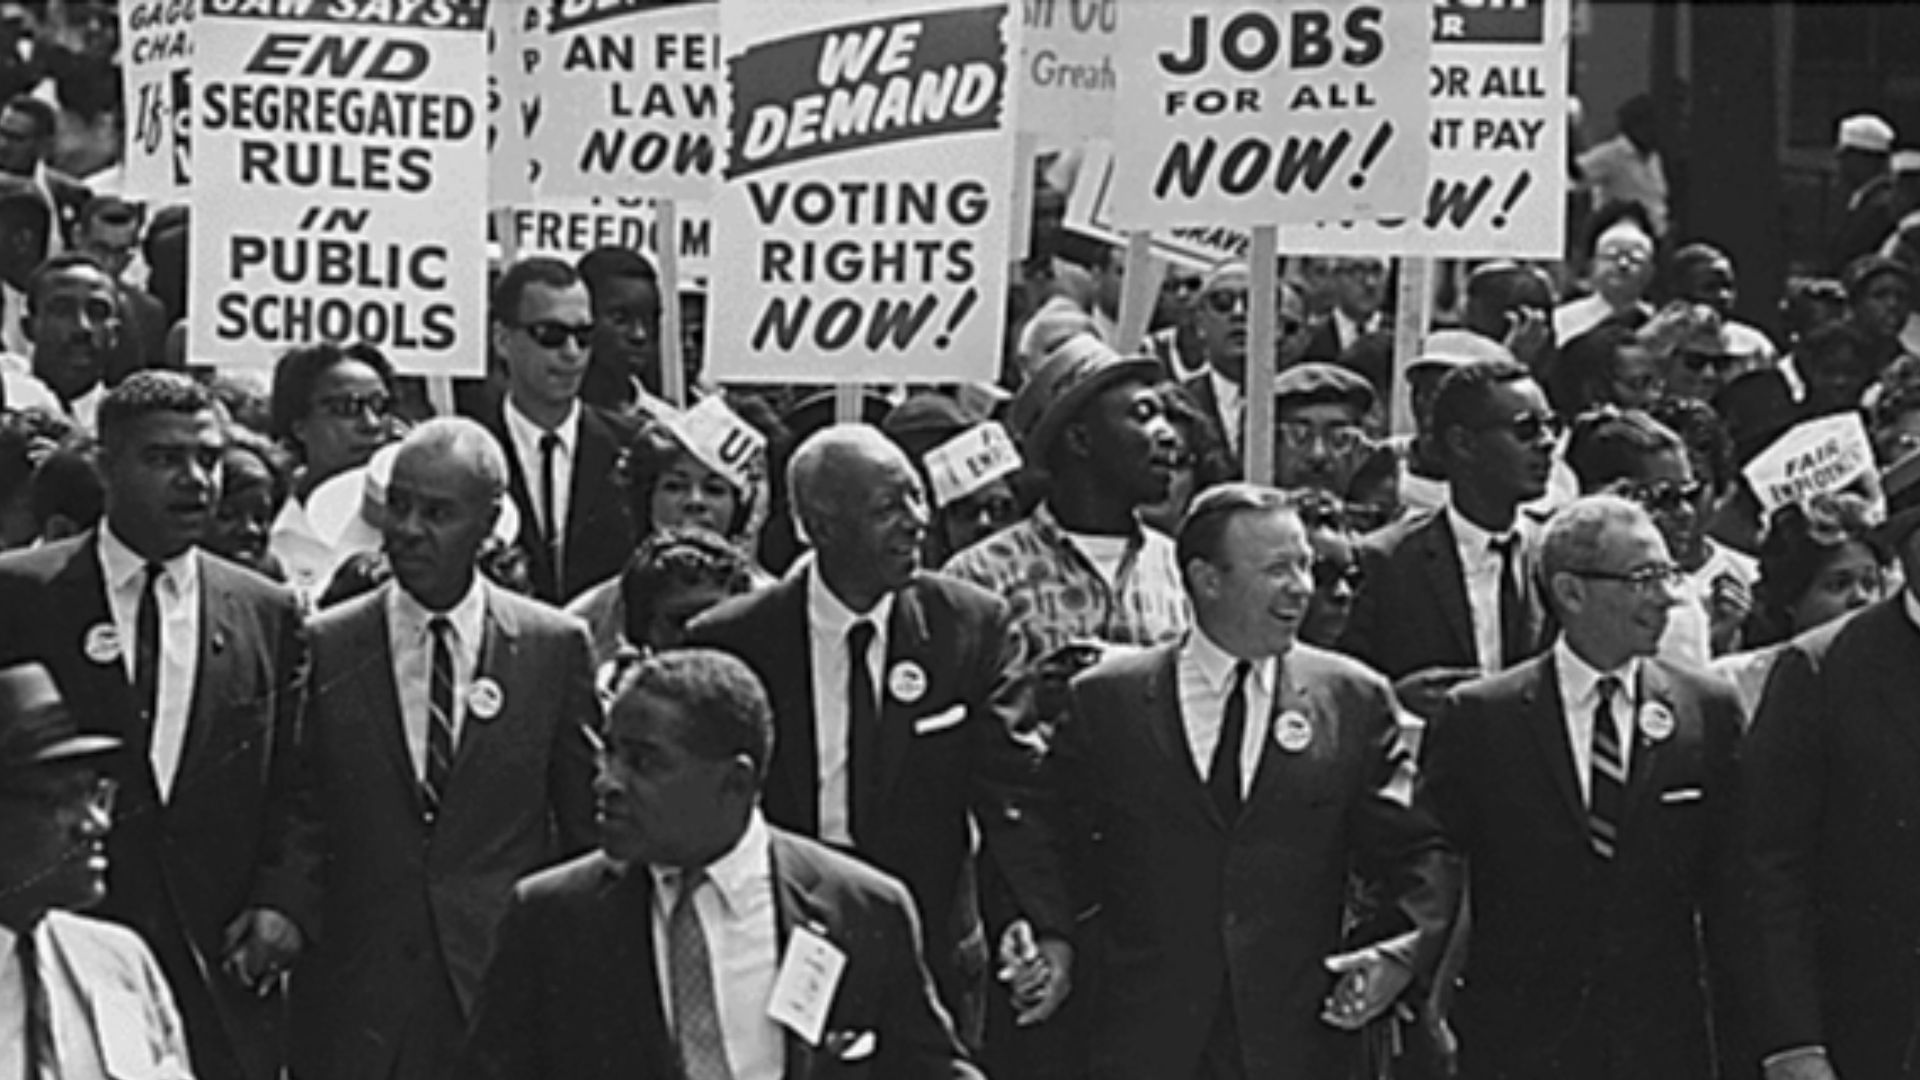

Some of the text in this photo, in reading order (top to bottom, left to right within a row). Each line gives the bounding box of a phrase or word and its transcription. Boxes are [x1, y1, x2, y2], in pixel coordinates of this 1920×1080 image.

[245, 33, 430, 81] END
[564, 33, 720, 71] AN FE
[817, 21, 923, 88] WE
[1159, 7, 1384, 75] JOBS
[1166, 83, 1377, 116] FOR ALL
[1480, 66, 1546, 98] ALL
[203, 84, 474, 139] SEGREGATED
[743, 62, 997, 161] DEMAND
[1473, 119, 1546, 151] PAY
[241, 141, 432, 191] RULES
[1155, 121, 1393, 199] NOW!
[300, 207, 370, 232] IN
[747, 181, 989, 226] VOTING
[514, 209, 711, 257] FREEDM
[231, 236, 447, 291] PUBLIC
[761, 240, 975, 283] RIGHTS
[217, 292, 456, 350] SCHOOLS
[751, 286, 978, 352] NOW!
